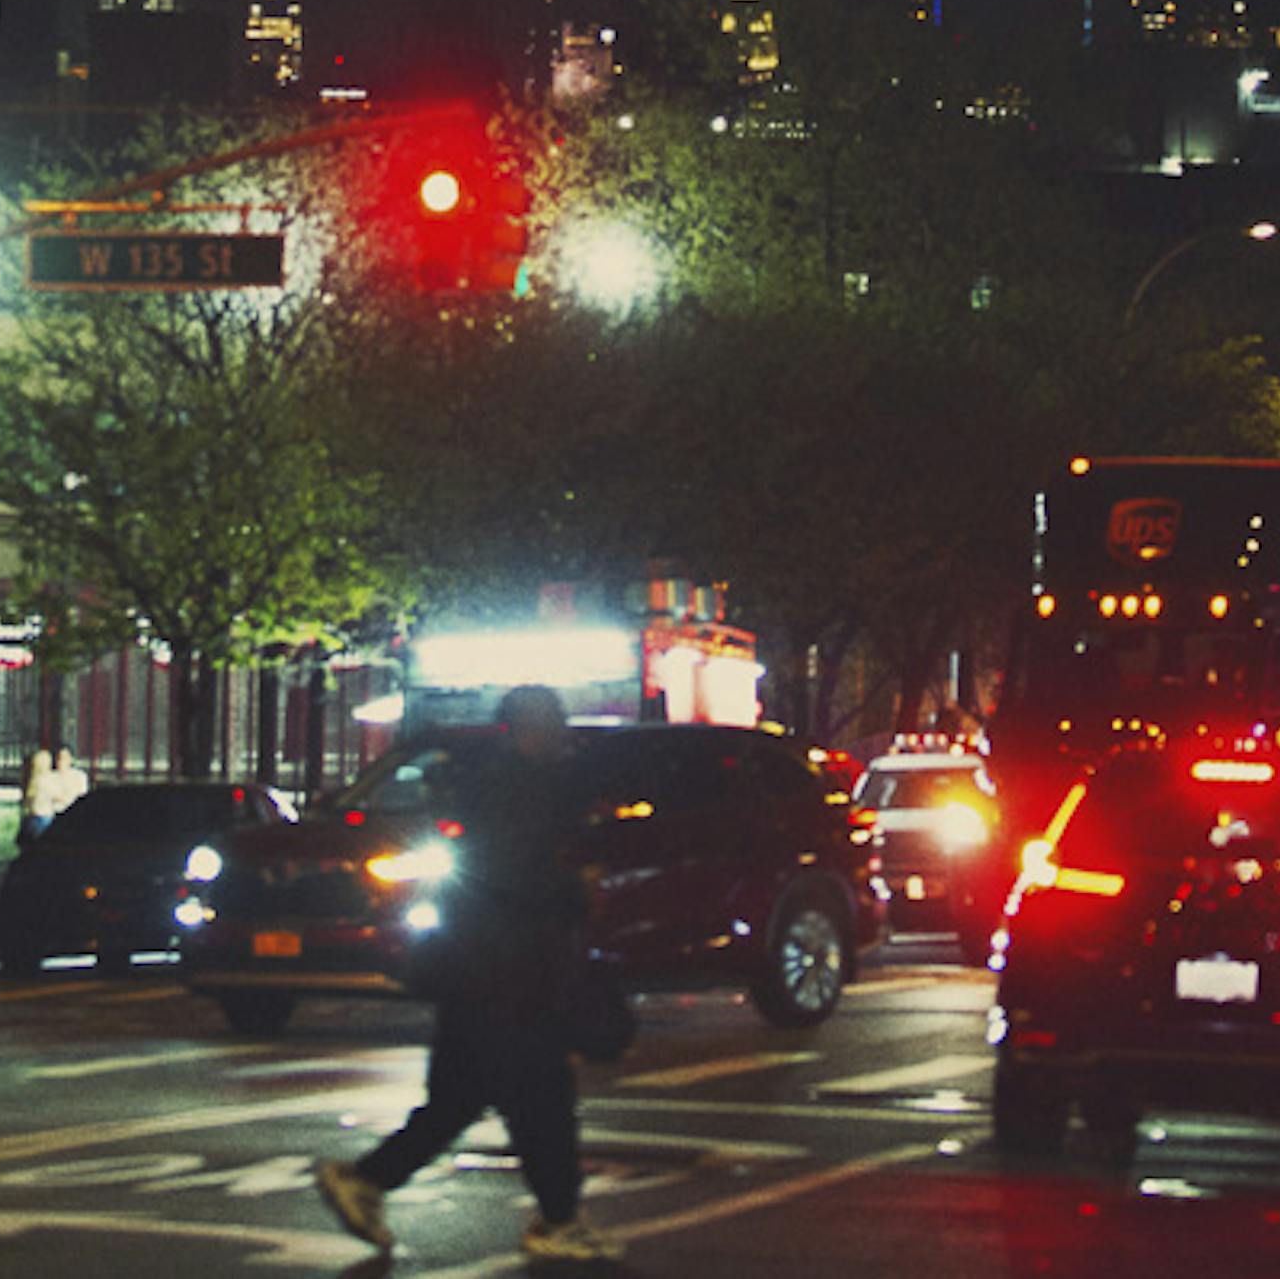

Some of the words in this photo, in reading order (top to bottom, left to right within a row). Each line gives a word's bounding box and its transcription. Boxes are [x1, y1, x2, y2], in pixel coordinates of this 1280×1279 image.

[79, 243, 111, 276] W
[128, 243, 183, 277] 135
[199, 243, 233, 277] St
